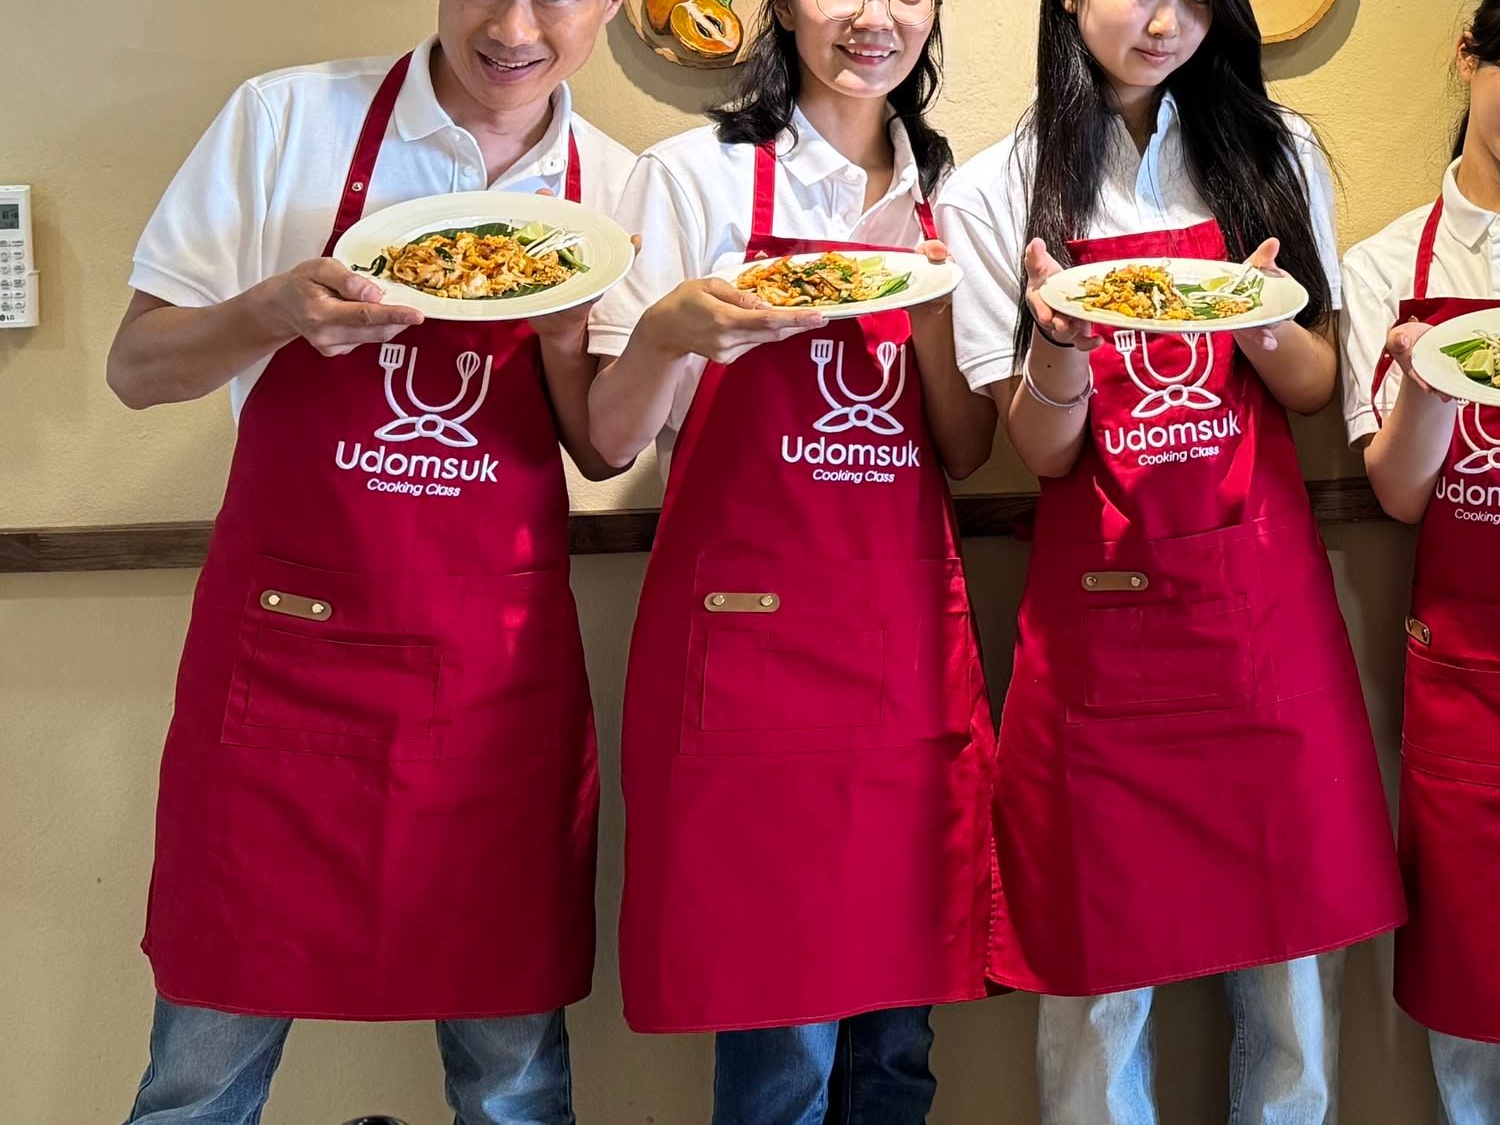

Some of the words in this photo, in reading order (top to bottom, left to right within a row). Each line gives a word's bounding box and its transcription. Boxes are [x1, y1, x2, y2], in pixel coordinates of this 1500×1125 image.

[1104, 410, 1241, 454] Udomsuk
[335, 441, 499, 482] Udomsuk
[781, 435, 920, 468] Udomsuk
[1138, 450, 1187, 466] Cooking
[1190, 445, 1220, 459] Class
[812, 469, 863, 484] Cooking
[865, 470, 895, 483] Class
[367, 478, 423, 497] Cooking
[425, 483, 461, 496] Class
[1454, 508, 1500, 525] Cooking
